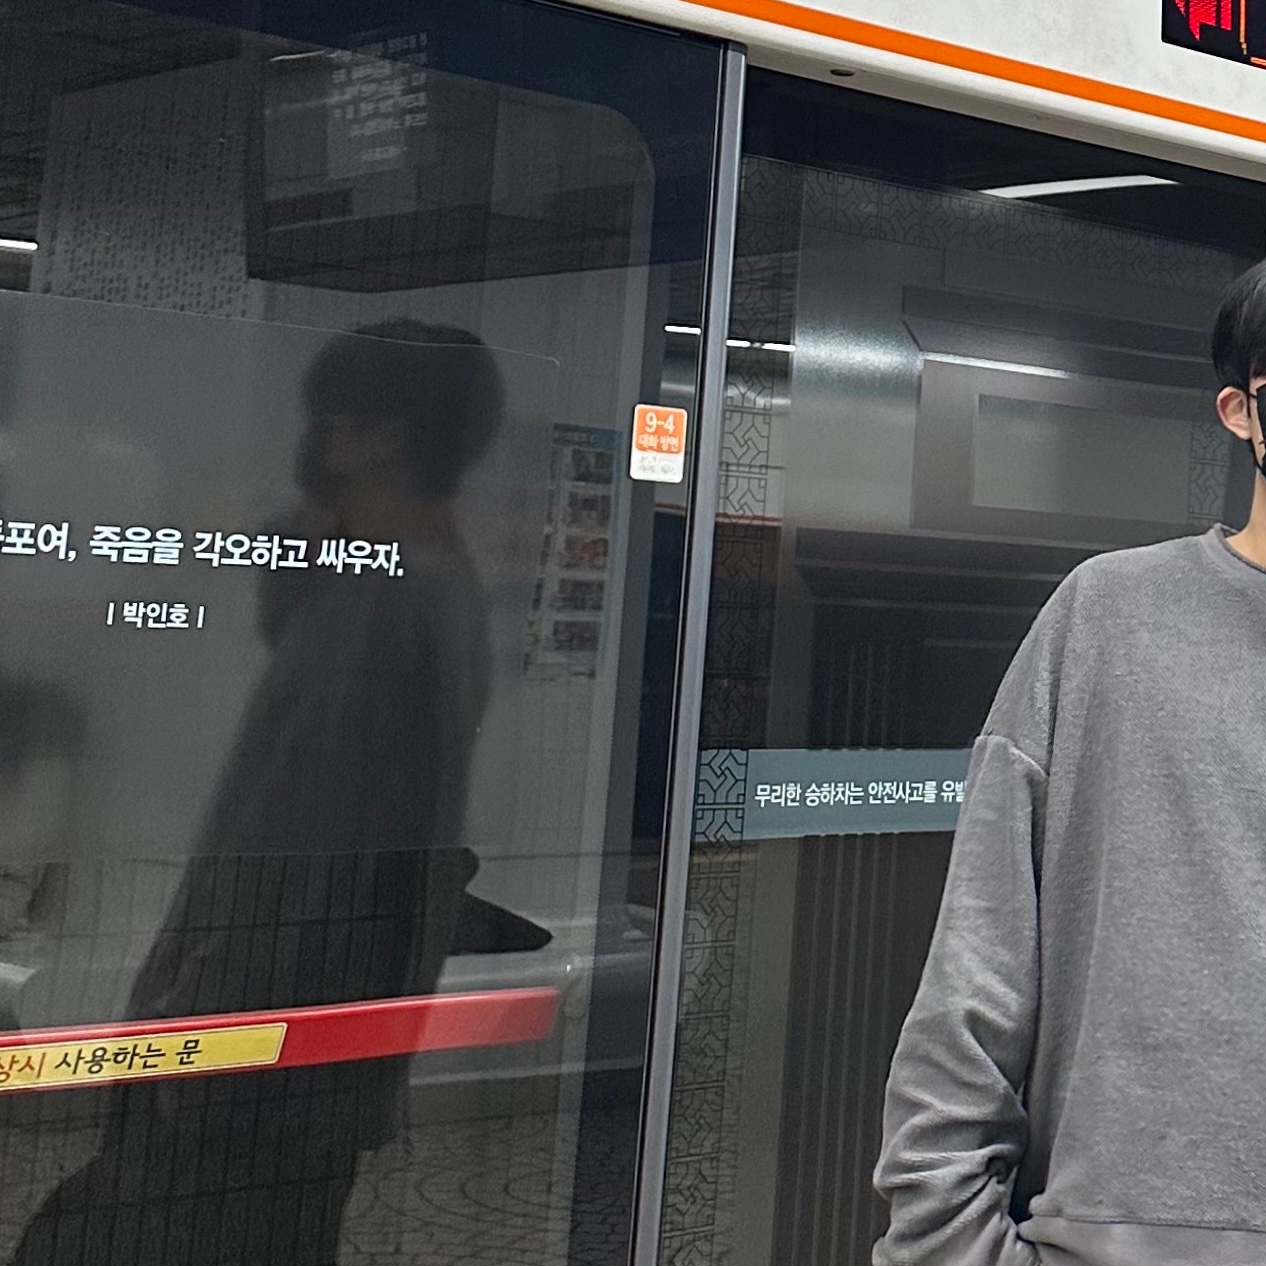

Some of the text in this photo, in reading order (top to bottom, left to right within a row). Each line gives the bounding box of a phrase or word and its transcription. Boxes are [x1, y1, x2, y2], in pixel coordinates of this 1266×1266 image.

[645, 411, 676, 435] 9-4
[0, 519, 404, 577] 포여, 죽음을 각오하고 싸우자.
[122, 602, 190, 629] 박인호
[754, 783, 801, 808] 무리한
[804, 782, 864, 807] 승하차는
[867, 780, 938, 804] 안전사고를
[54, 1043, 166, 1075] 사용하는
[175, 1039, 203, 1066] 문
